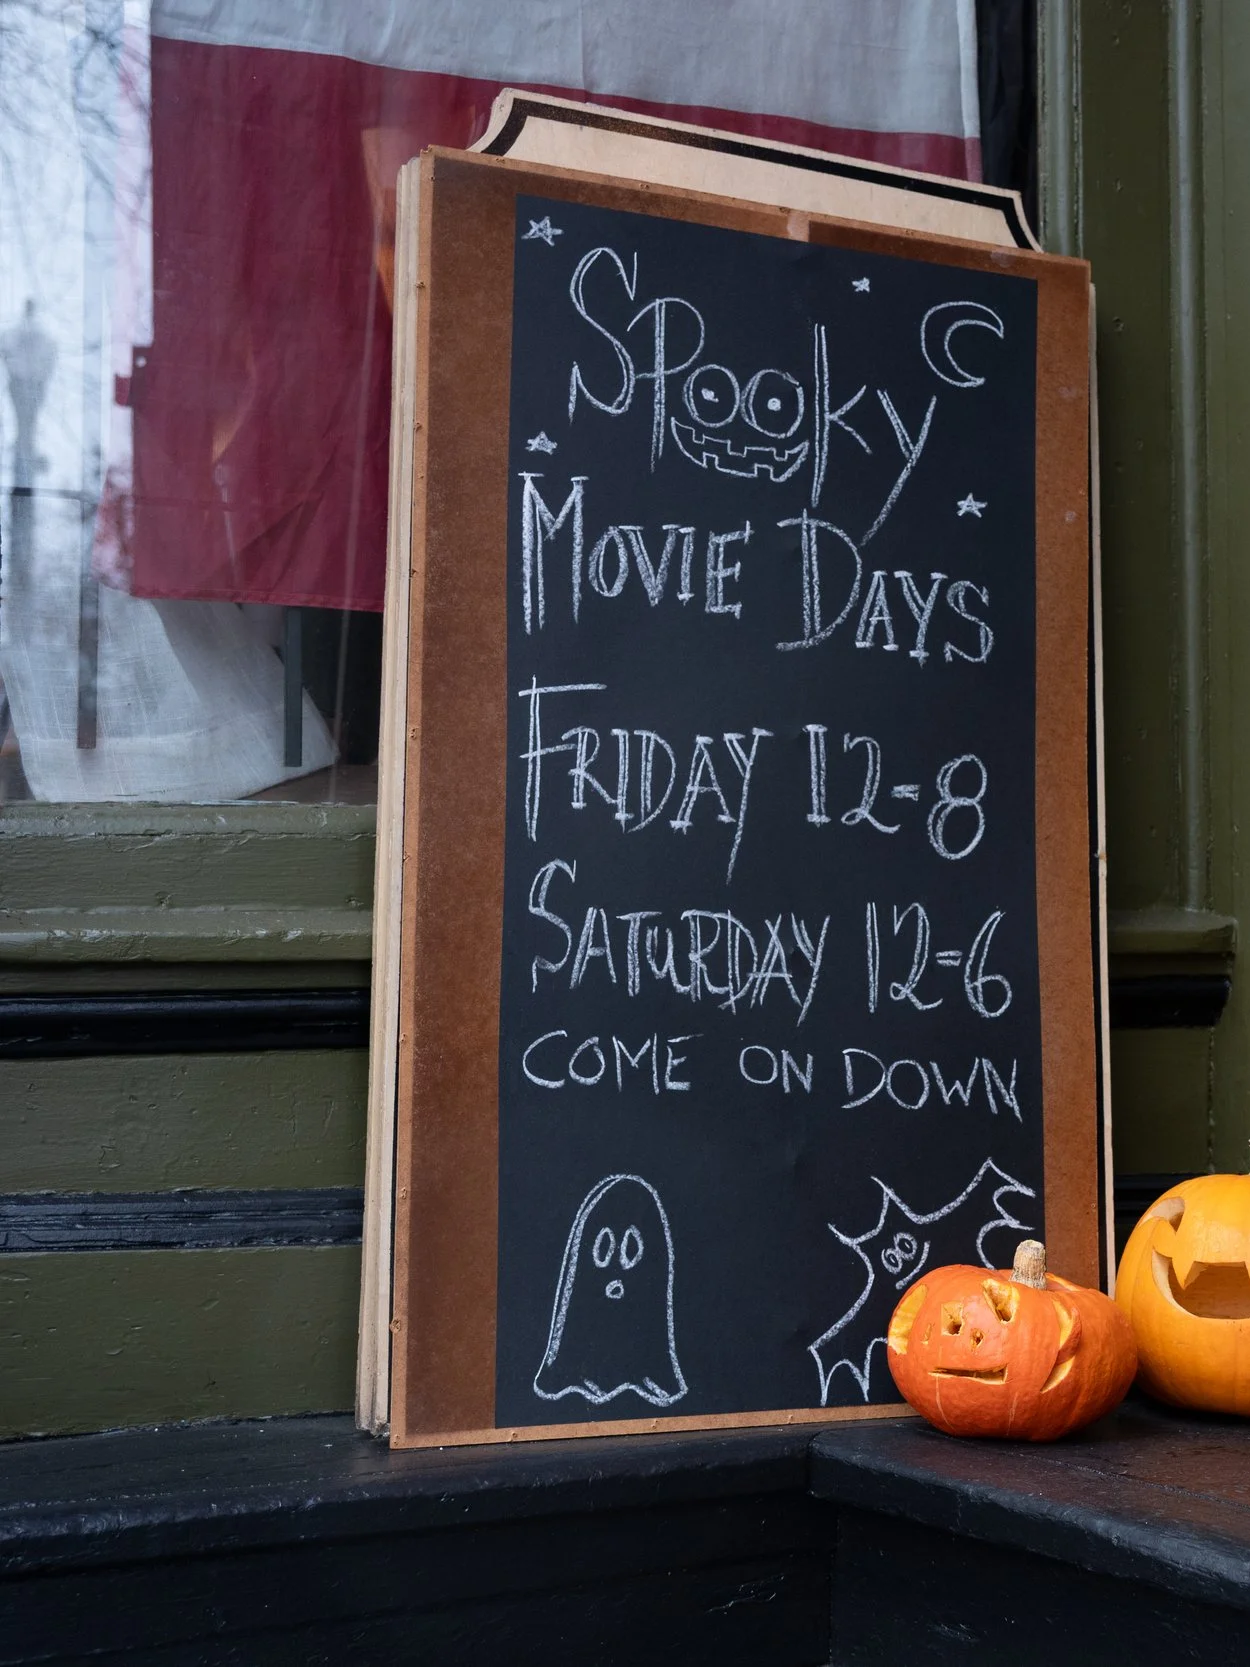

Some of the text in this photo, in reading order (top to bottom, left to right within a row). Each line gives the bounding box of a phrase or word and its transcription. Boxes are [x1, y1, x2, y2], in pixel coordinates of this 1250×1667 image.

[518, 471, 994, 667] MOVIE DAYS
[518, 675, 774, 885] FRIDAY
[522, 1030, 1023, 1123] COME ON DOWN
